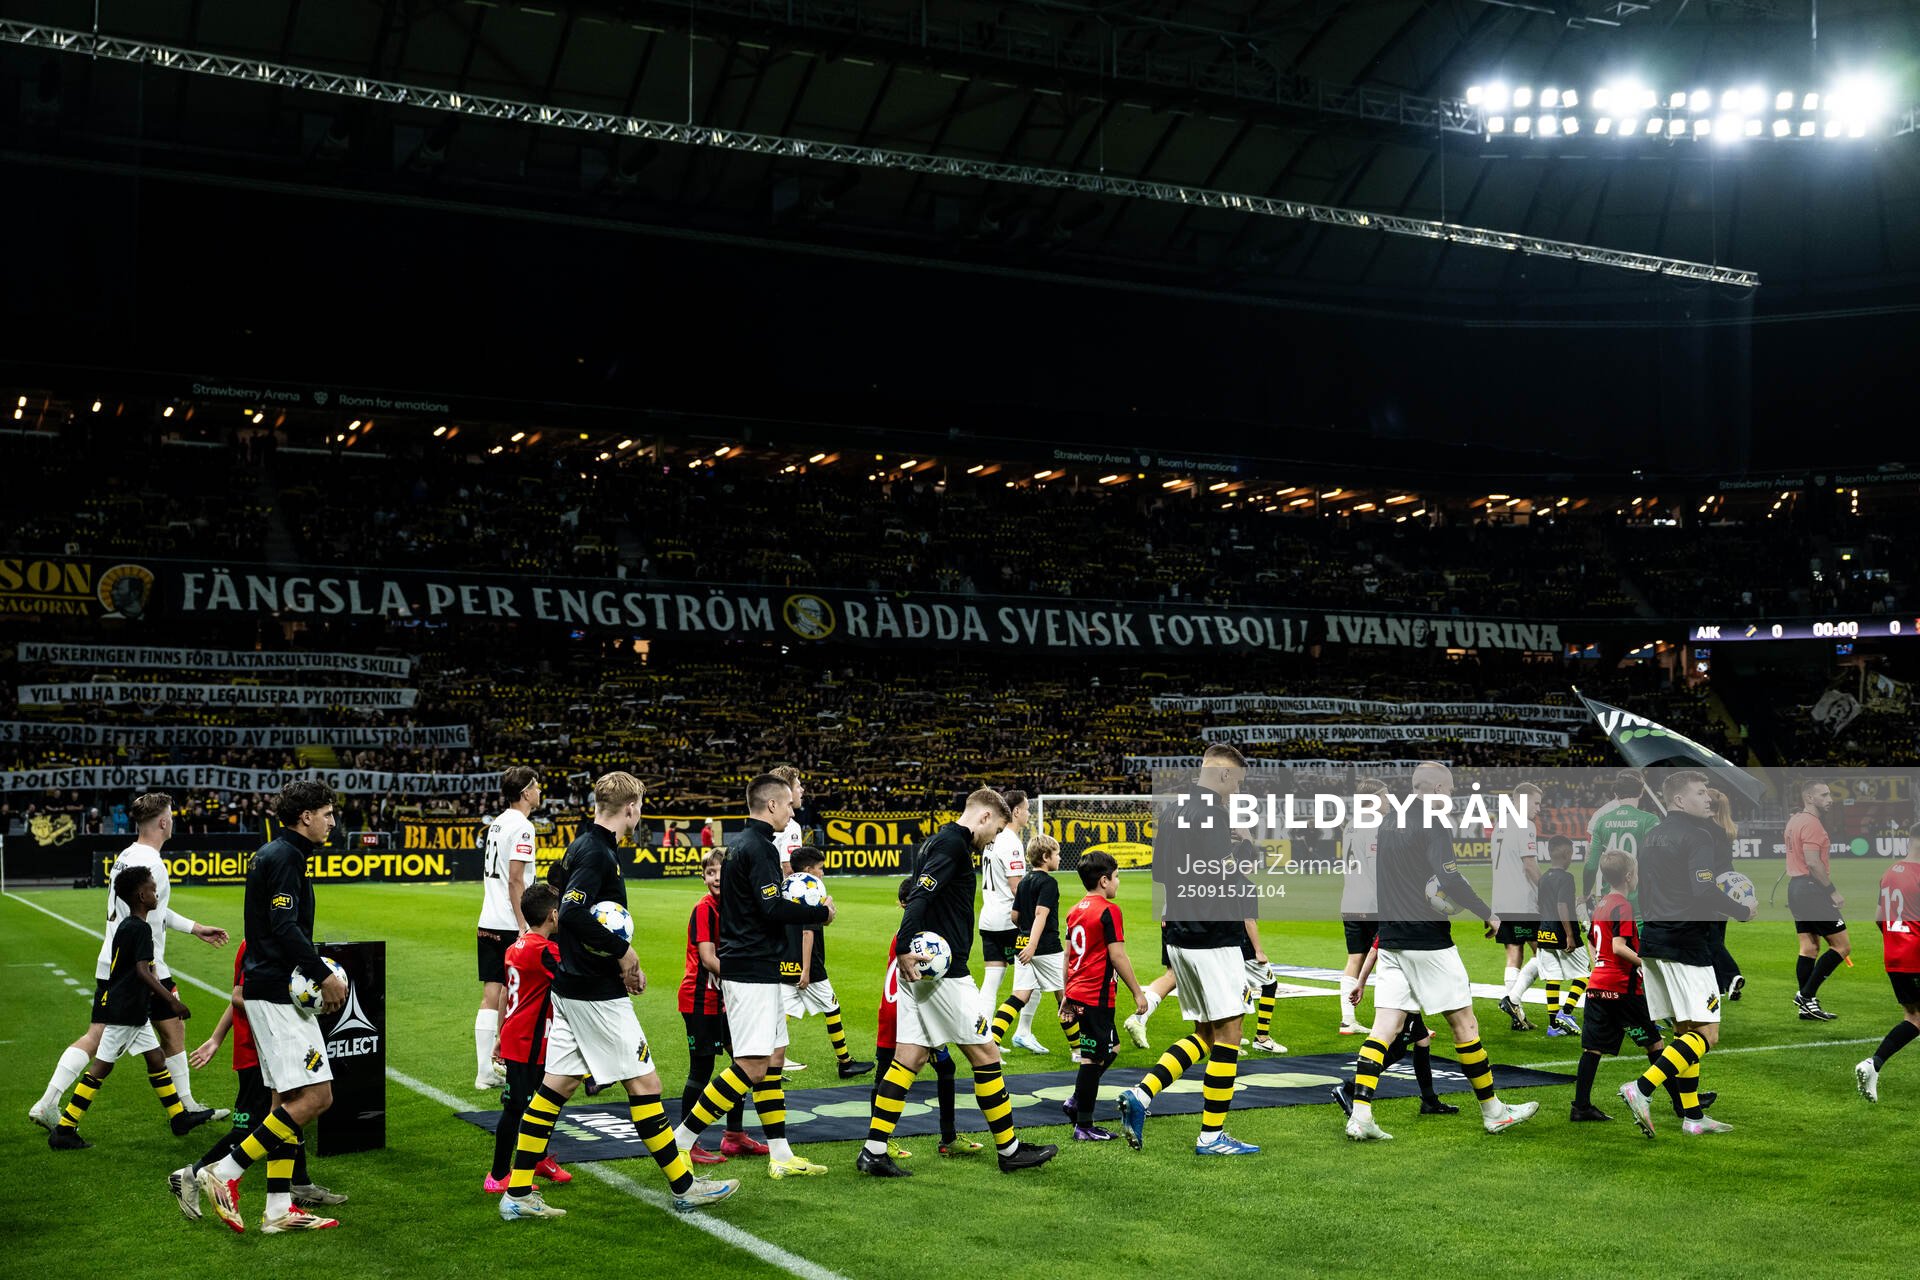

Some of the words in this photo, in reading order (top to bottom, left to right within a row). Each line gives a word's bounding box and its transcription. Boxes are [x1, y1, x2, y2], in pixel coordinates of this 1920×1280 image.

[191, 382, 263, 400] Strawberry
[264, 388, 300, 401] Arena
[338, 393, 376, 406] Room
[377, 396, 392, 408] for
[394, 399, 449, 413] emotions
[1053, 448, 1102, 464] Strawberry
[1105, 452, 1131, 464] Arena
[1157, 457, 1184, 468] Room
[1186, 459, 1197, 469] for
[1198, 461, 1238, 472] emotions
[1719, 479, 1772, 490] Strawberry
[1775, 478, 1804, 488] Arena
[1835, 474, 1864, 485] Room
[1865, 473, 1880, 482] for
[181, 567, 420, 617] FÄNGSLA
[425, 581, 521, 620] PER
[531, 586, 776, 633] ENGSTRÖM
[843, 596, 991, 643] RÄDDA
[999, 605, 1141, 648] SVENSK
[1149, 611, 1308, 654] FOTBOLL!
[1324, 612, 1414, 647] IVAN
[1431, 618, 1563, 652] TURINA
[1696, 625, 1721, 640] AIK
[1772, 624, 1783, 638] 0
[1813, 621, 1859, 637] 00:00
[1889, 620, 1901, 635] 0
[25, 646, 135, 663] MASKERINGEN
[140, 649, 182, 665] FINNS
[186, 648, 212, 666] FÖR
[217, 648, 357, 670] LÄKTARKULTURENS
[361, 655, 404, 675] SKULL
[31, 686, 63, 703] VILL
[71, 686, 87, 702] NI
[92, 686, 114, 701] HA
[119, 686, 161, 702] BORT
[167, 687, 204, 703] DEN?
[208, 688, 298, 705] LEGALISERA
[303, 689, 403, 706] PYROTEKNIK!
[1563, 708, 1588, 720] BARN
[19, 724, 97, 744] REKORD
[103, 726, 157, 745] EFTER
[163, 727, 237, 746] REKORD
[242, 730, 266, 746] AV
[270, 725, 467, 747] PUBLIKTILLSTRÖMNING
[1208, 728, 1249, 743] ENDAST
[1252, 729, 1264, 741] EN
[1295, 728, 1316, 740] KAN
[1318, 728, 1329, 739] SE
[1332, 727, 1403, 740] PROPORTIONER
[1406, 727, 1425, 739] OCH
[1427, 727, 1482, 740] RIMLIGHET
[1509, 731, 1535, 744] UTAN
[1536, 732, 1562, 745] SKAM
[1124, 758, 1147, 774] PER
[12, 767, 95, 788] POLISEN
[102, 764, 188, 786] FÖRSLAG
[195, 766, 250, 789] EFTER
[345, 772, 373, 789] OM
[404, 825, 477, 849] BLACK
[1495, 838, 1505, 870] 7
[1881, 886, 1911, 933] 12
[1016, 935, 1031, 948] SVE
[1071, 924, 1087, 972] 9
[505, 965, 521, 1019] 8
[326, 1035, 379, 1059] SELECT
